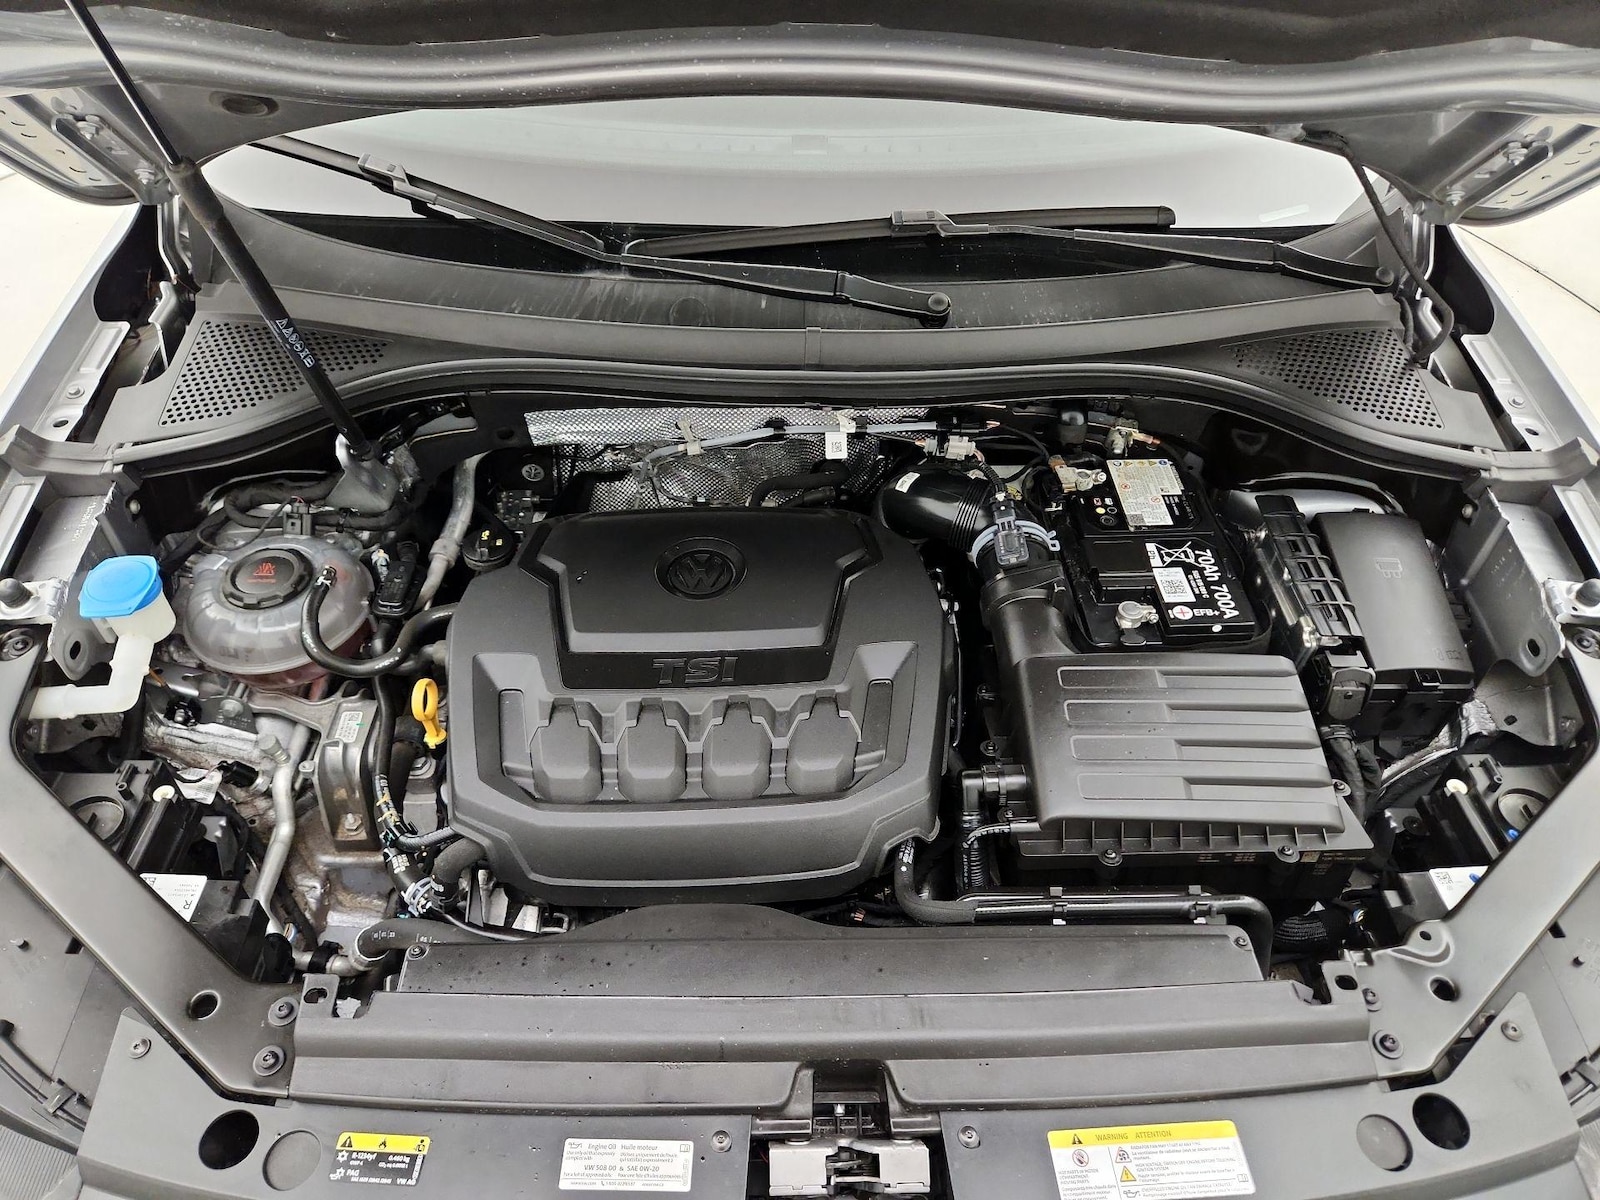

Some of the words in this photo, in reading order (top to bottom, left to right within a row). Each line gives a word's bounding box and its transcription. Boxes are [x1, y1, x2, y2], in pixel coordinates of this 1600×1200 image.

[1195, 549, 1221, 581] 70Ah
[1210, 584, 1240, 619] 700A
[1193, 608, 1221, 617] EFB+
[652, 656, 739, 685] TSI
[1095, 1132, 1129, 1141] WARNING
[1135, 1130, 1172, 1139] ATTENTION
[588, 1143, 607, 1151] Engine
